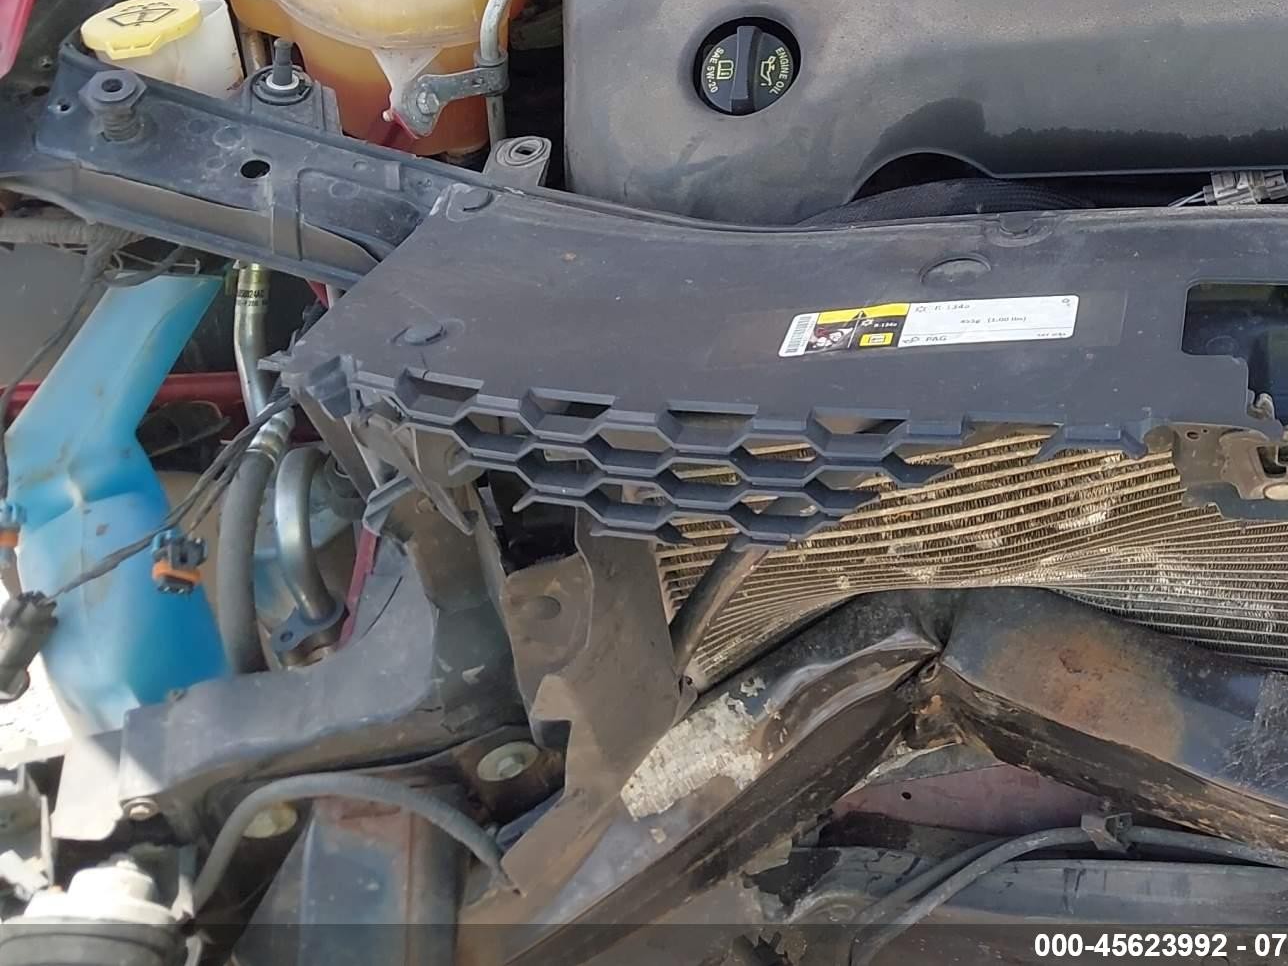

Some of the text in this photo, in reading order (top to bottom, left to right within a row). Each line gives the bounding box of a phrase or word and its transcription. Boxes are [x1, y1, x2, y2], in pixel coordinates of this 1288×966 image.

[710, 47, 724, 64] SAE
[769, 46, 790, 95] ENGINE OIL
